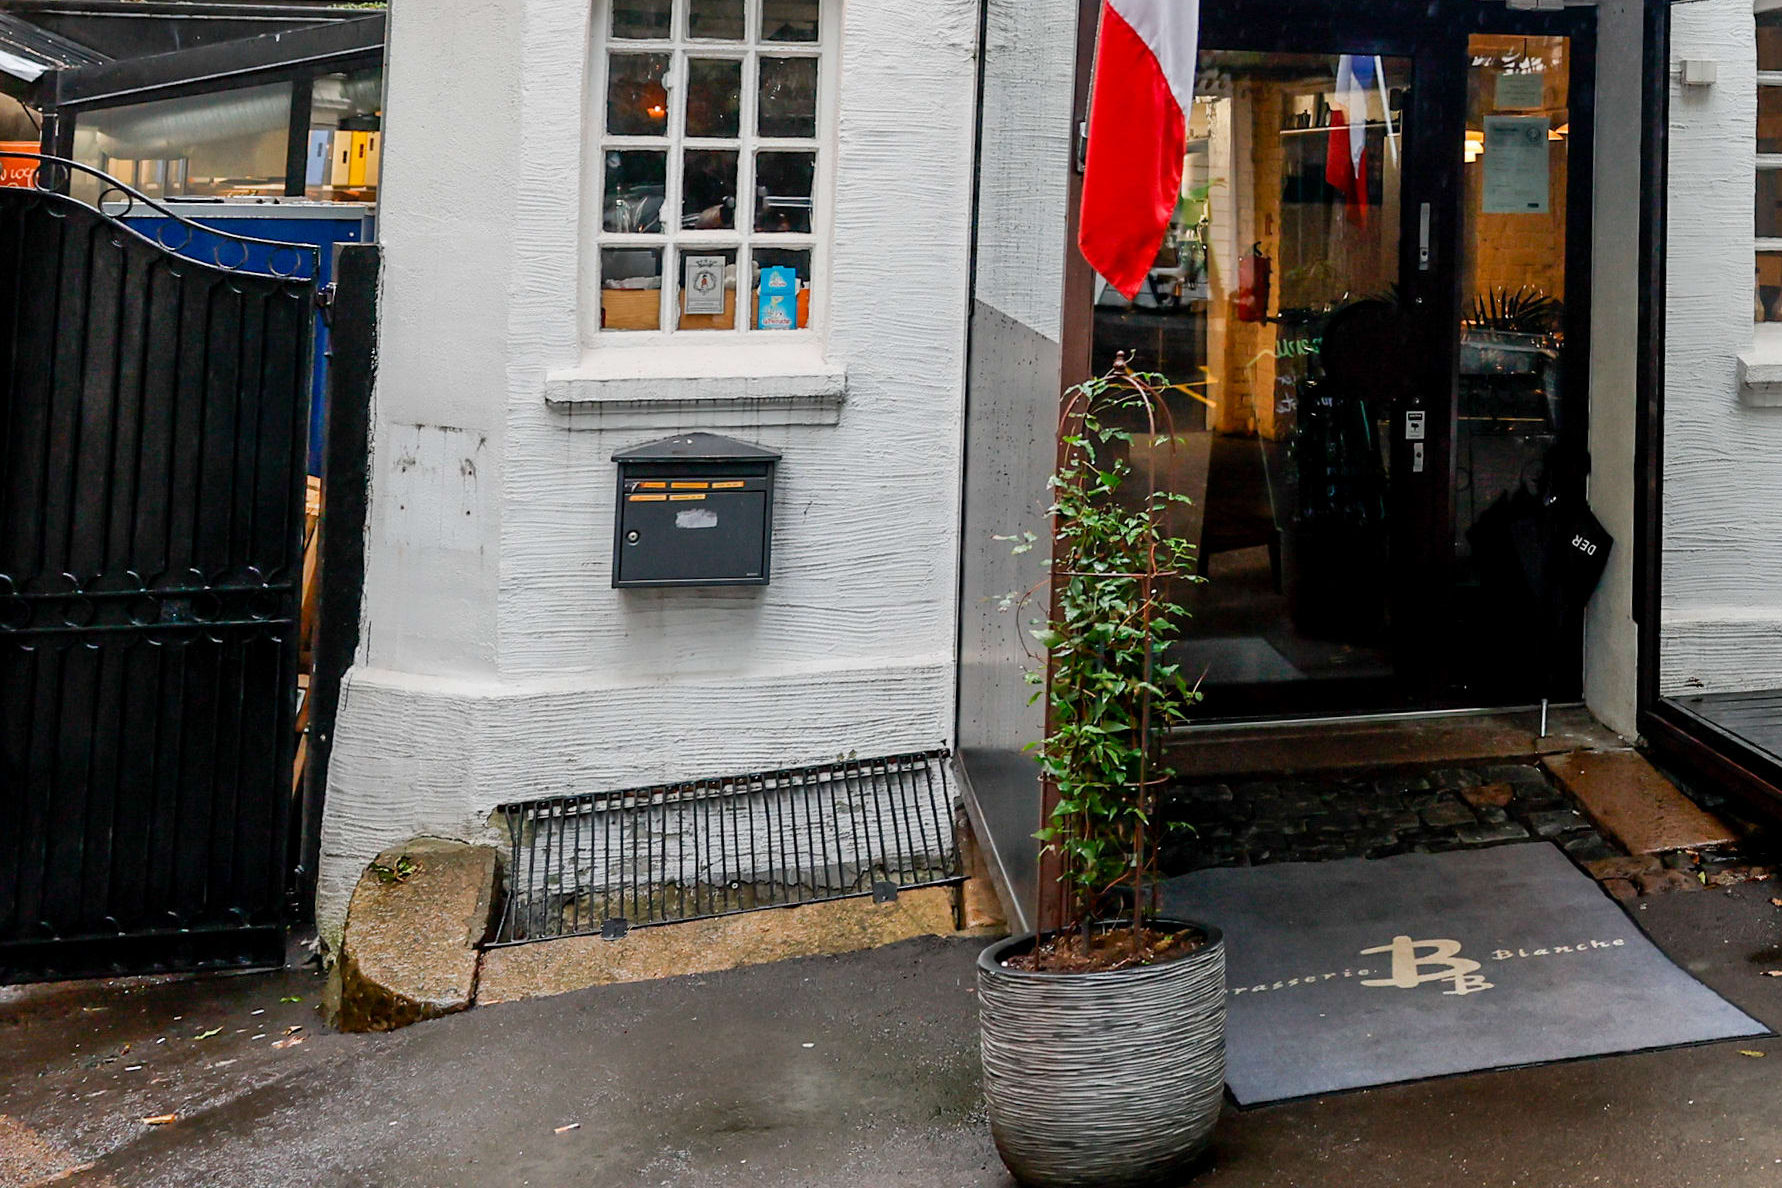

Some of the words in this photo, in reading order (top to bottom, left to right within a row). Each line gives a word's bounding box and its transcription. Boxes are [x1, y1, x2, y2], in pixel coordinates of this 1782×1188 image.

[1571, 534, 1598, 556] DER
[1491, 936, 1626, 961] Blanche
[1226, 966, 1371, 994] rasserie
